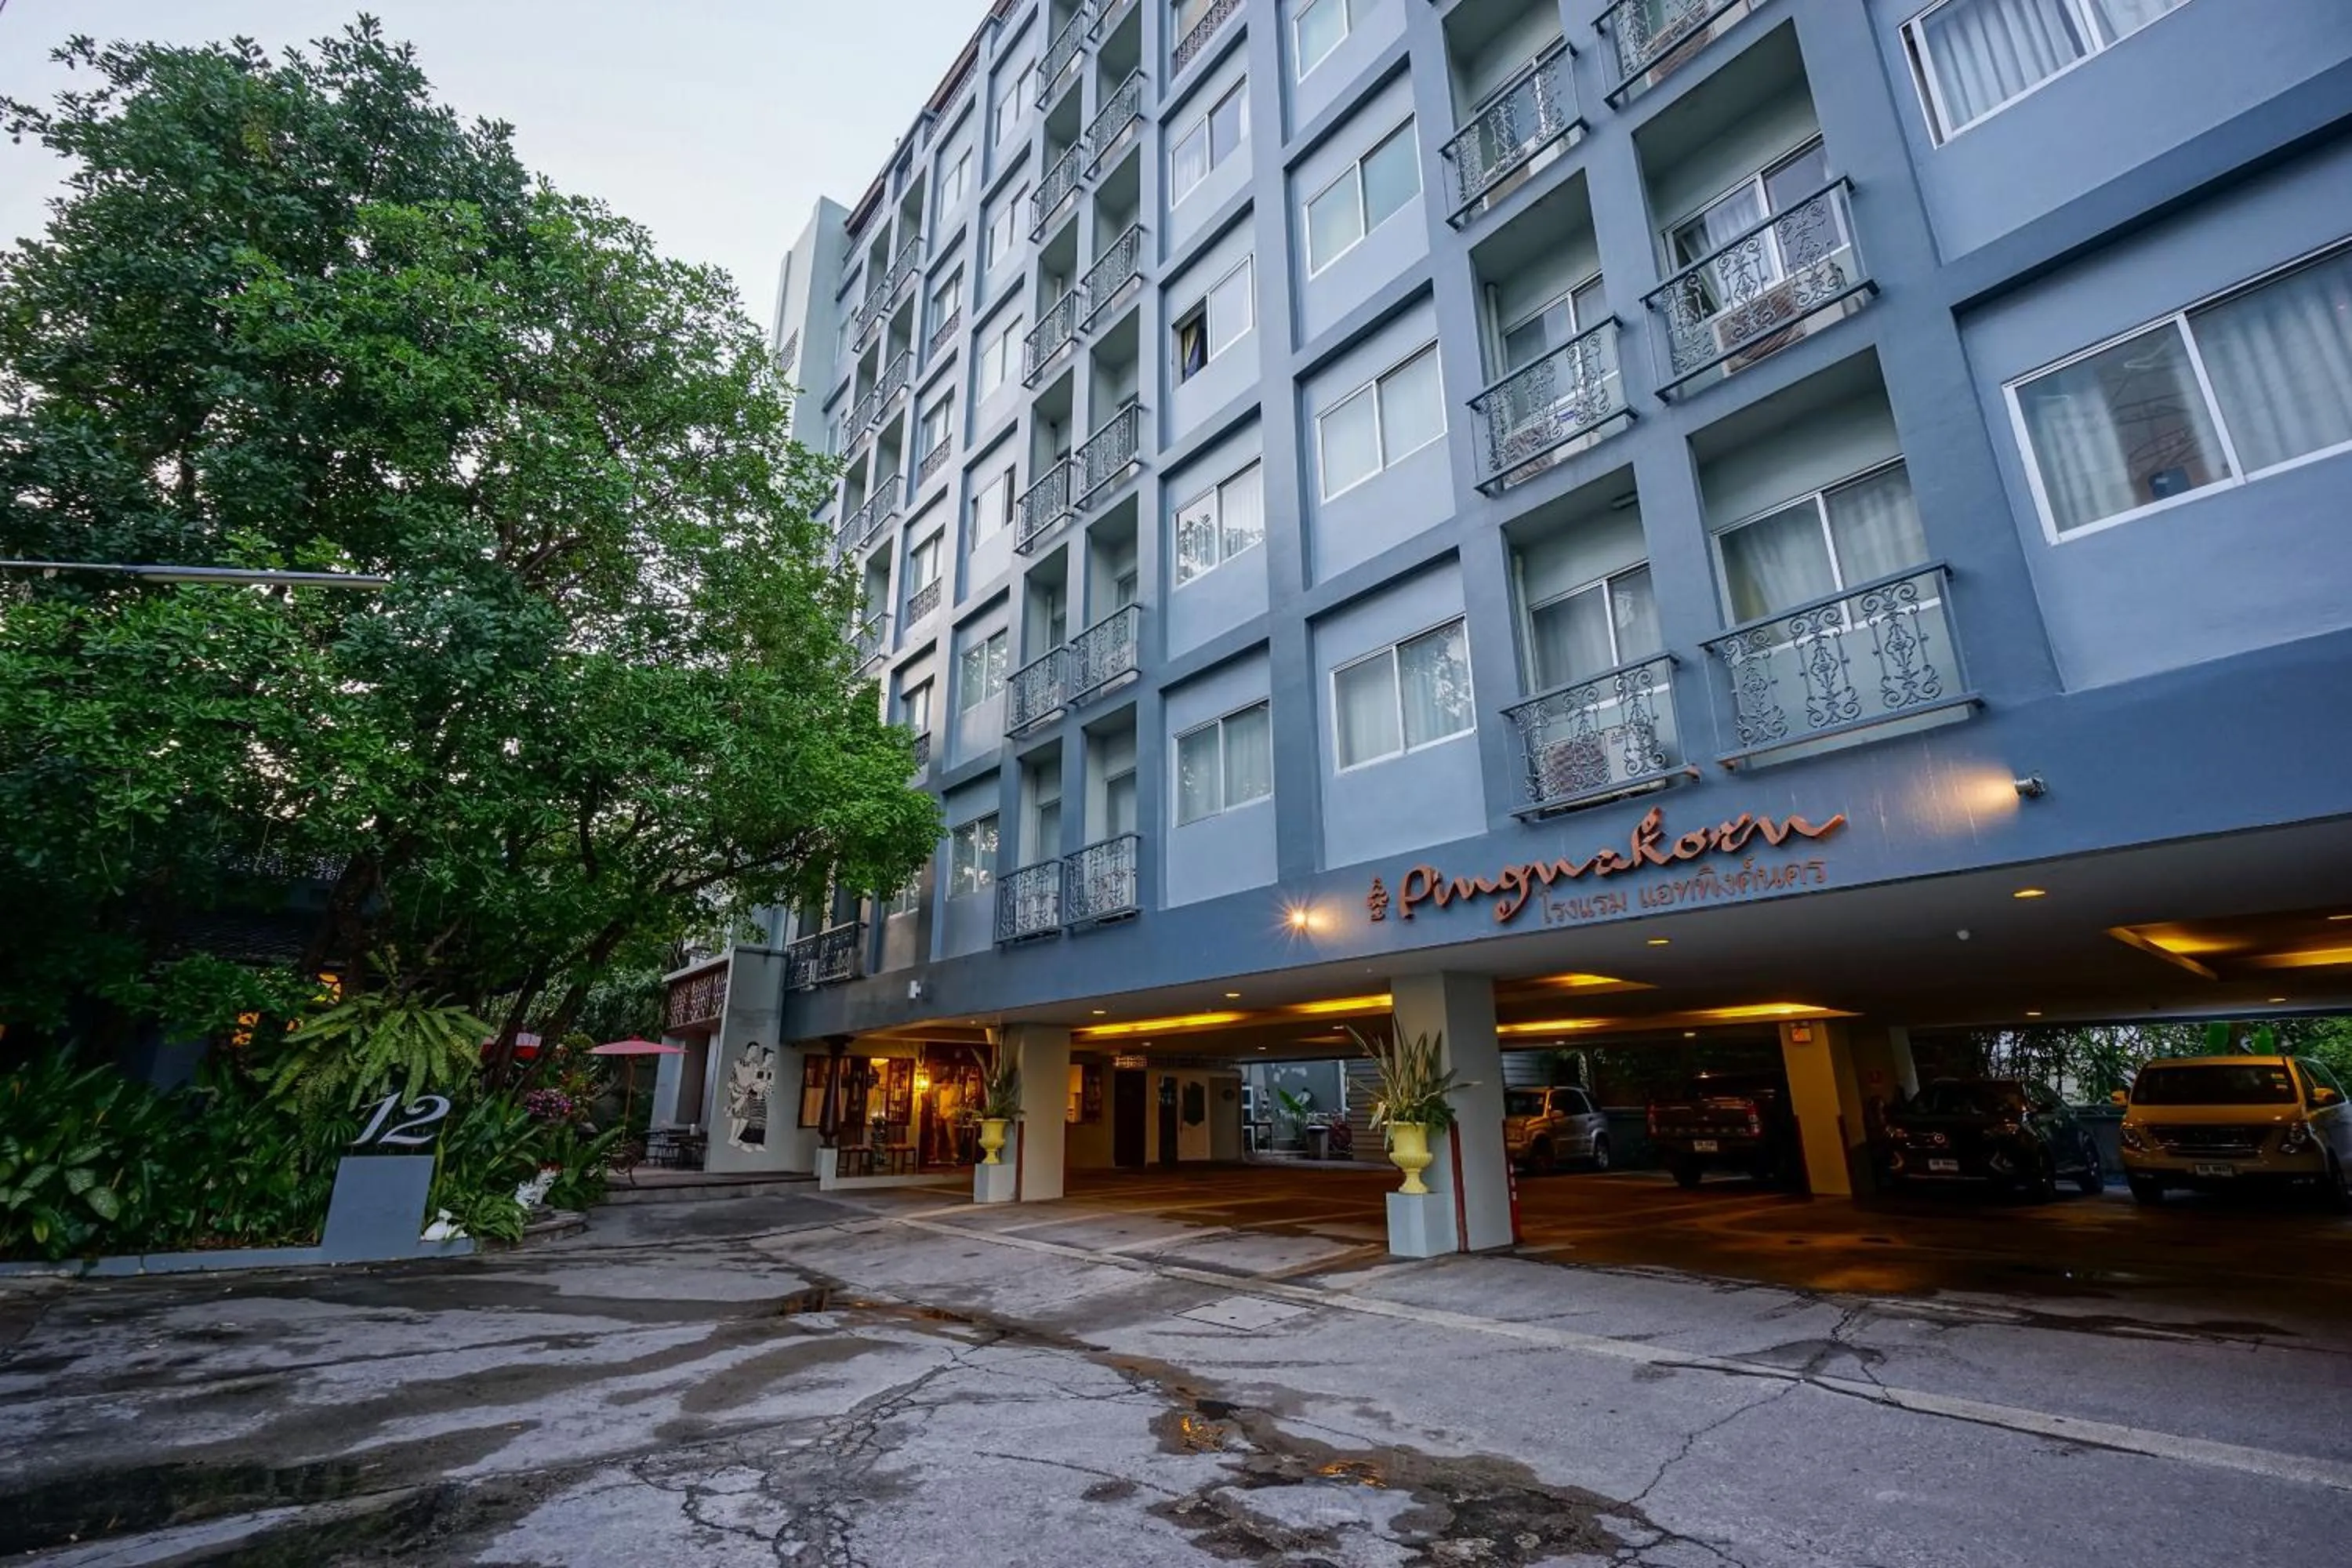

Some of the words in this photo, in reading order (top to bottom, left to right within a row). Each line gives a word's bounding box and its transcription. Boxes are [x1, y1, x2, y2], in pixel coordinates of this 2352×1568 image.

[1539, 884, 1628, 924] โรงแรม
[348, 1091, 450, 1145] 12
